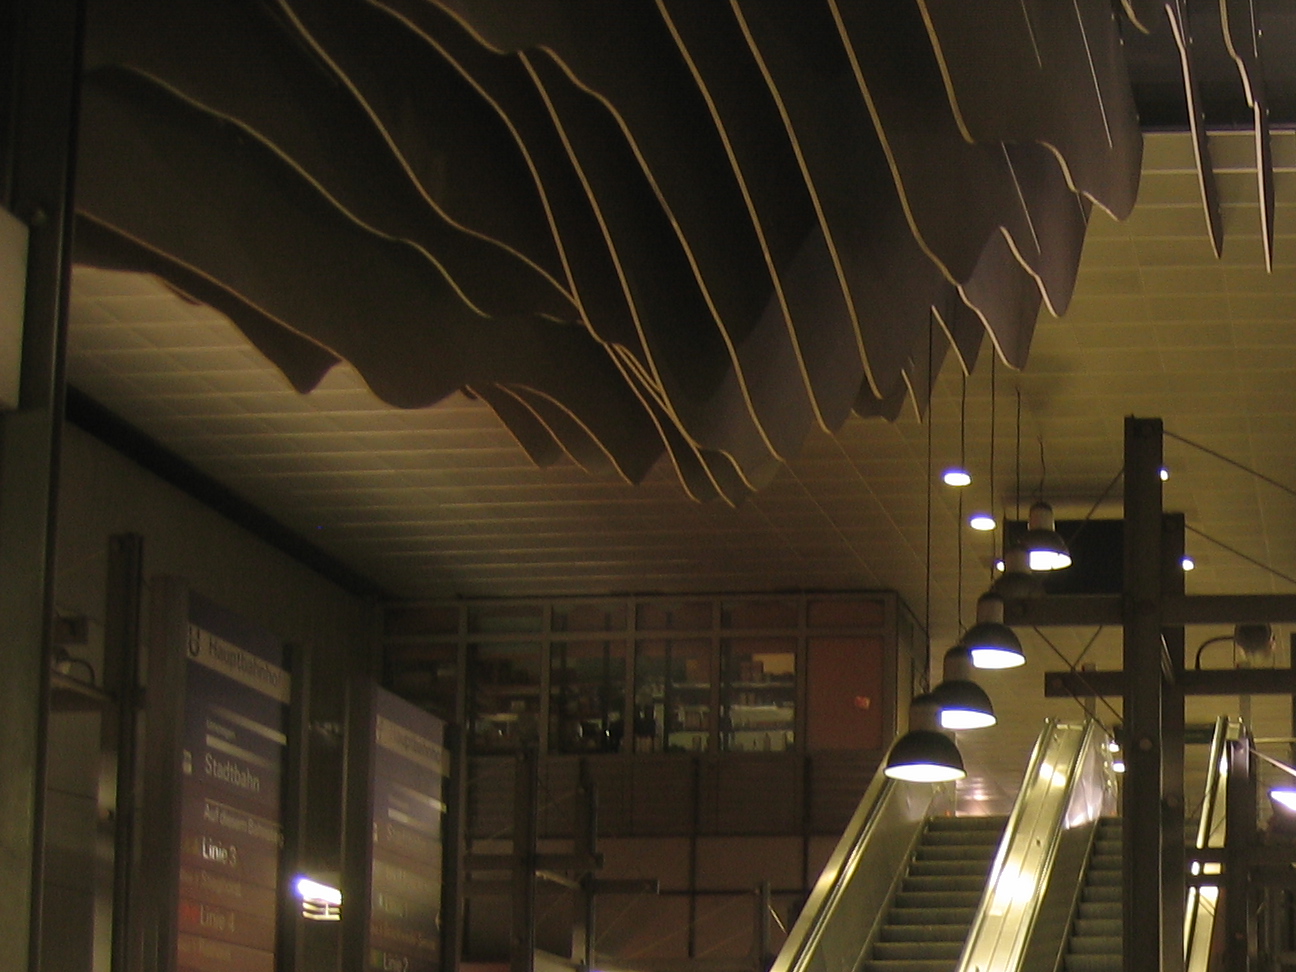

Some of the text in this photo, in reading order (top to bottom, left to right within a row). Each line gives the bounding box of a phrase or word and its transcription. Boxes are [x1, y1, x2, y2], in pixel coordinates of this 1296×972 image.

[205, 752, 260, 793] Stadtbahn
[202, 836, 237, 867] Linie 3
